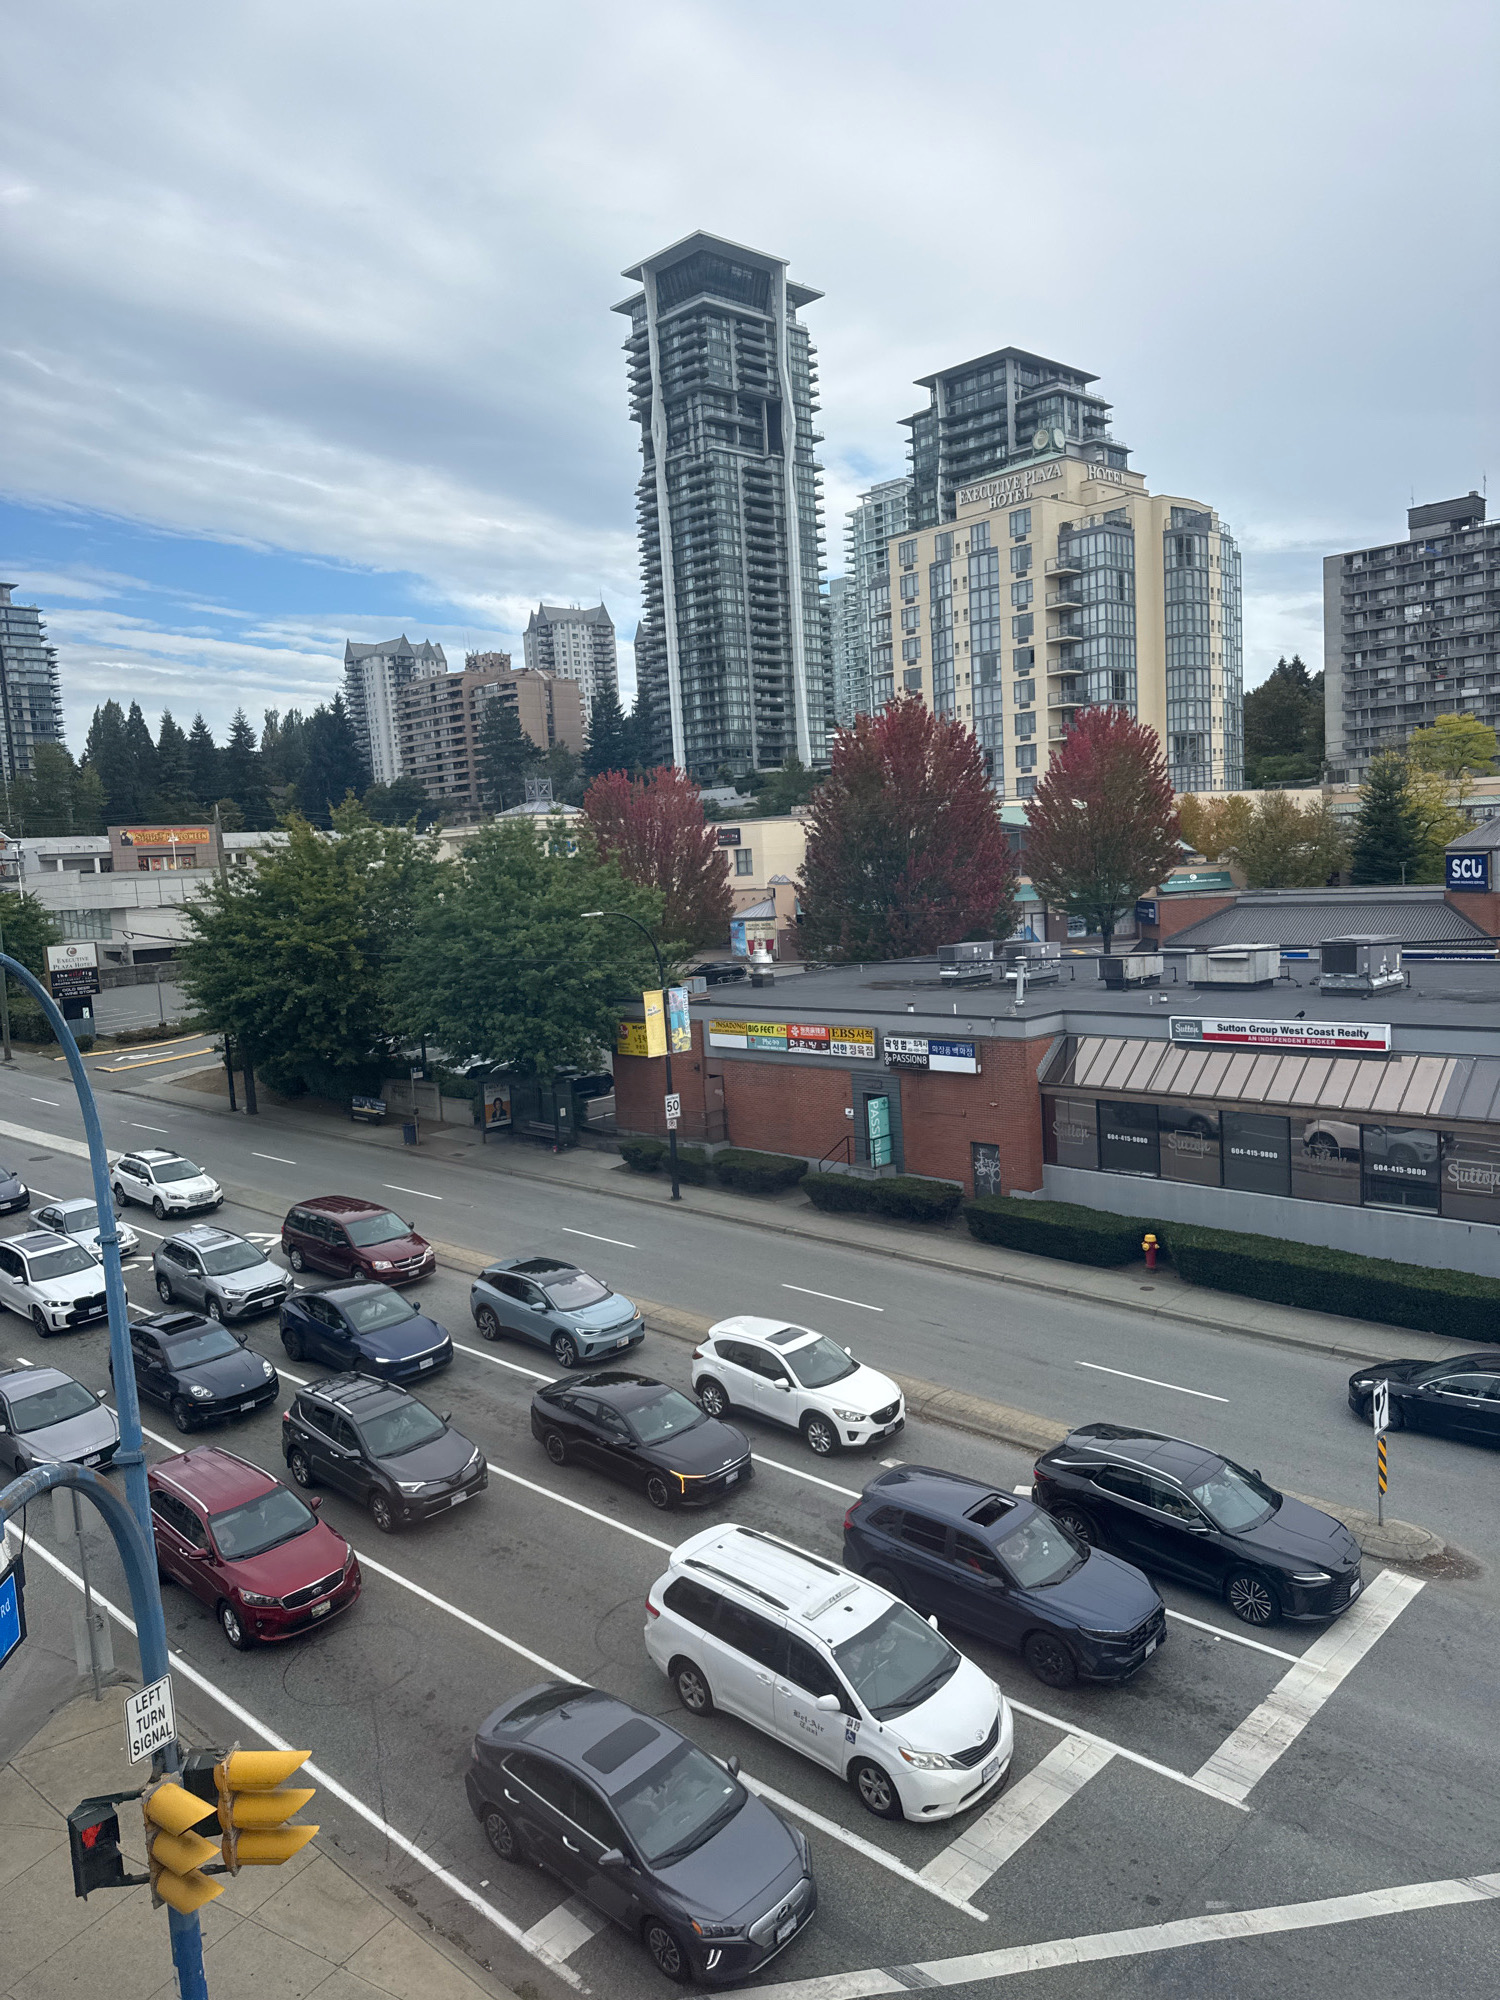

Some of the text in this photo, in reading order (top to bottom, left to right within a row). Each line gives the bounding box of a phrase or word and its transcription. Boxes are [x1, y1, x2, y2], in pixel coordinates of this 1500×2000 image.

[1088, 464, 1127, 486] HOTEL
[958, 464, 1062, 505] EXECUTIVE PLAZA
[989, 487, 1032, 510] HOTEL
[1452, 859, 1482, 878] SCU
[57, 956, 89, 964] EXECUTIVE
[748, 1025, 759, 1033] BIG
[760, 1025, 774, 1034] FEET
[1175, 1023, 1199, 1034] Sutton
[1217, 1023, 1369, 1039] Sutton Group West Coast Realty
[892, 1054, 928, 1065] PASSION8
[667, 1100, 679, 1112] 50
[1053, 1120, 1089, 1138] Sutton
[1168, 1133, 1210, 1151] Sutton
[1231, 1147, 1278, 1159] 604-415-9800
[1373, 1163, 1427, 1176] 604-415-9800
[0, 1598, 10, 1618] Rd
[135, 1686, 161, 1714] LEFT
[136, 1704, 166, 1733] TURN
[133, 1722, 173, 1756] SIGNAL
